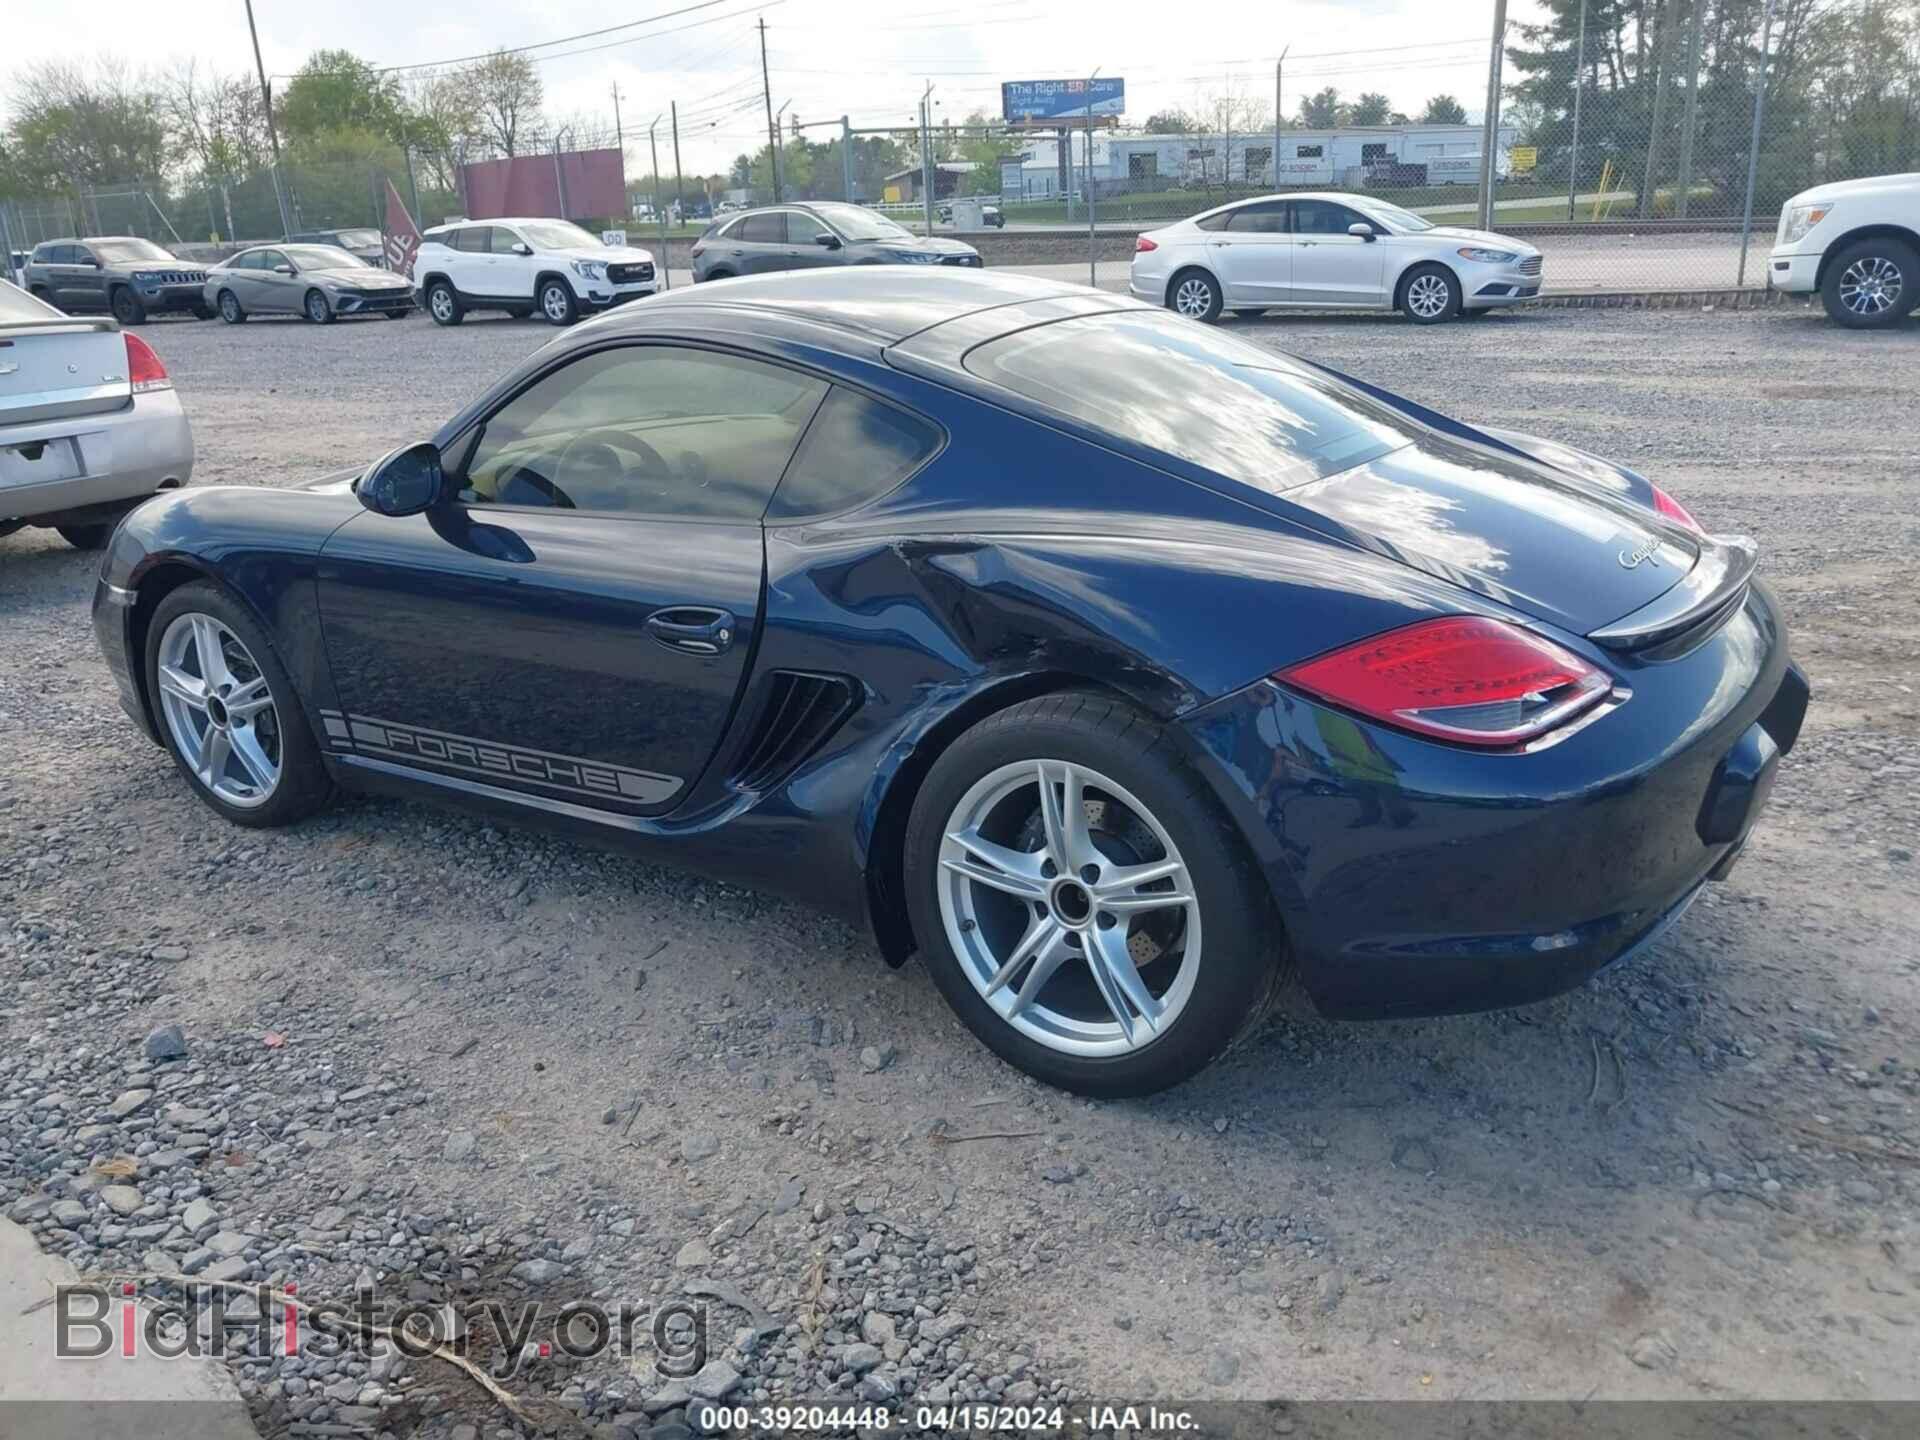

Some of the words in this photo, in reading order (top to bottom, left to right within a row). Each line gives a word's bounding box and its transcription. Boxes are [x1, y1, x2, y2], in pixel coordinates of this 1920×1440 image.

[1010, 84, 1032, 96] The
[1034, 82, 1065, 97] Right
[1067, 80, 1084, 93] ER
[385, 727, 624, 793] PORSCHE
